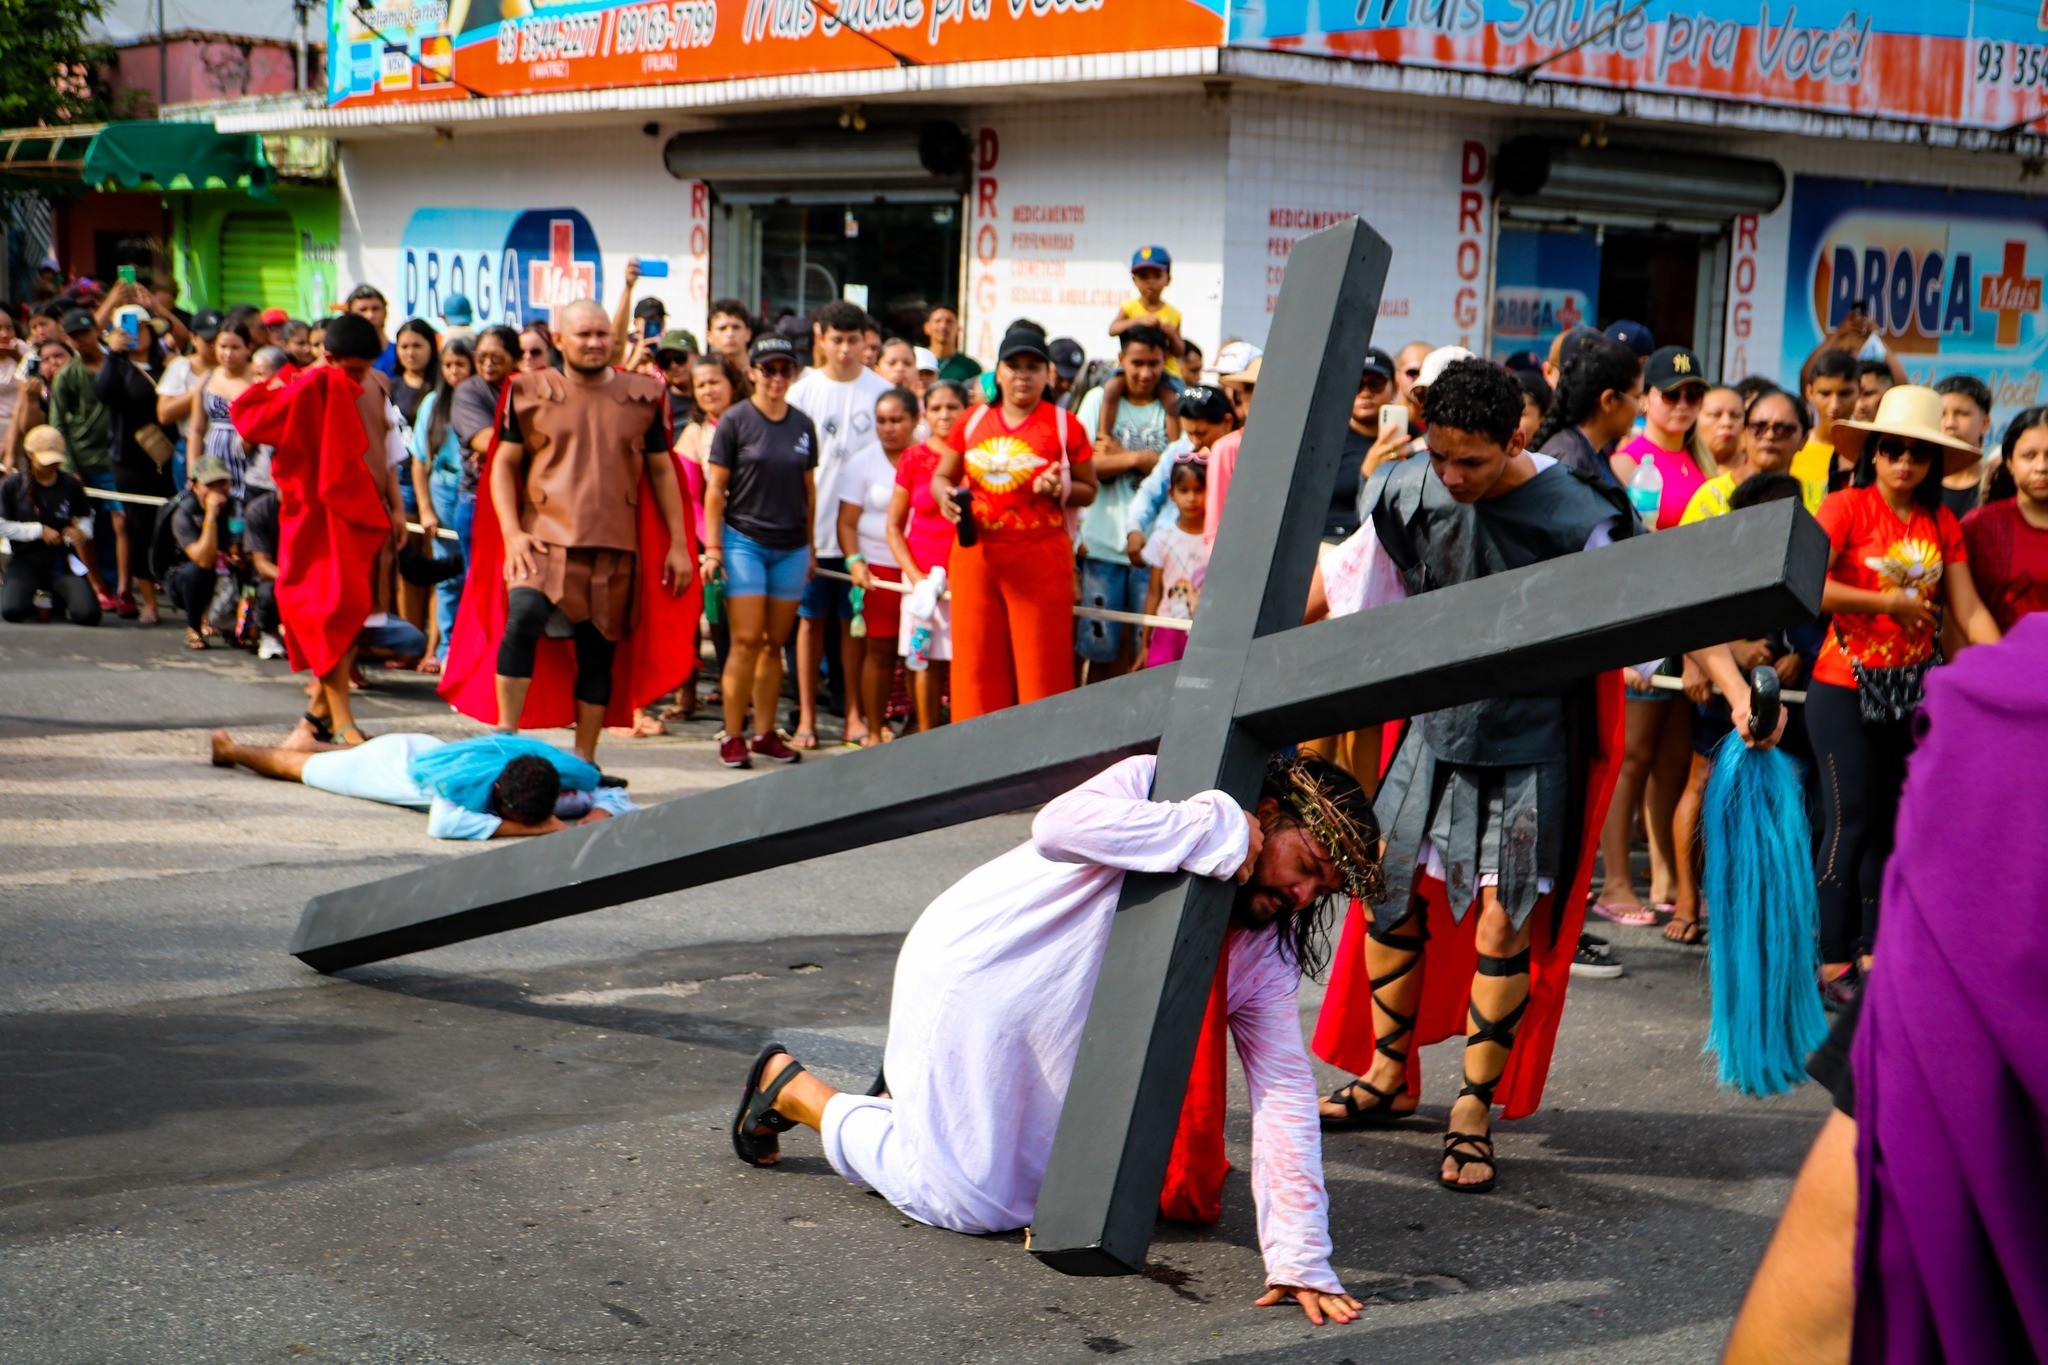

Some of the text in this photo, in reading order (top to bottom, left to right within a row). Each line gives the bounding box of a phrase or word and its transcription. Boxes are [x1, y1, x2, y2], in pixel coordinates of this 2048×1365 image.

[497, 18, 518, 63] 93
[615, 0, 717, 54] 99163-7799
[1658, 12, 1737, 84] pra
[1757, 3, 1870, 84] Você!
[1977, 42, 2004, 82] 93
[1012, 205, 1085, 223] MEDICAMENTOS
[1270, 208, 1357, 229] MEDICAMENT
[404, 248, 521, 329] DROGA
[541, 266, 588, 304] Mais
[1826, 242, 1974, 338] DROGA
[1983, 275, 2037, 310] Mais
